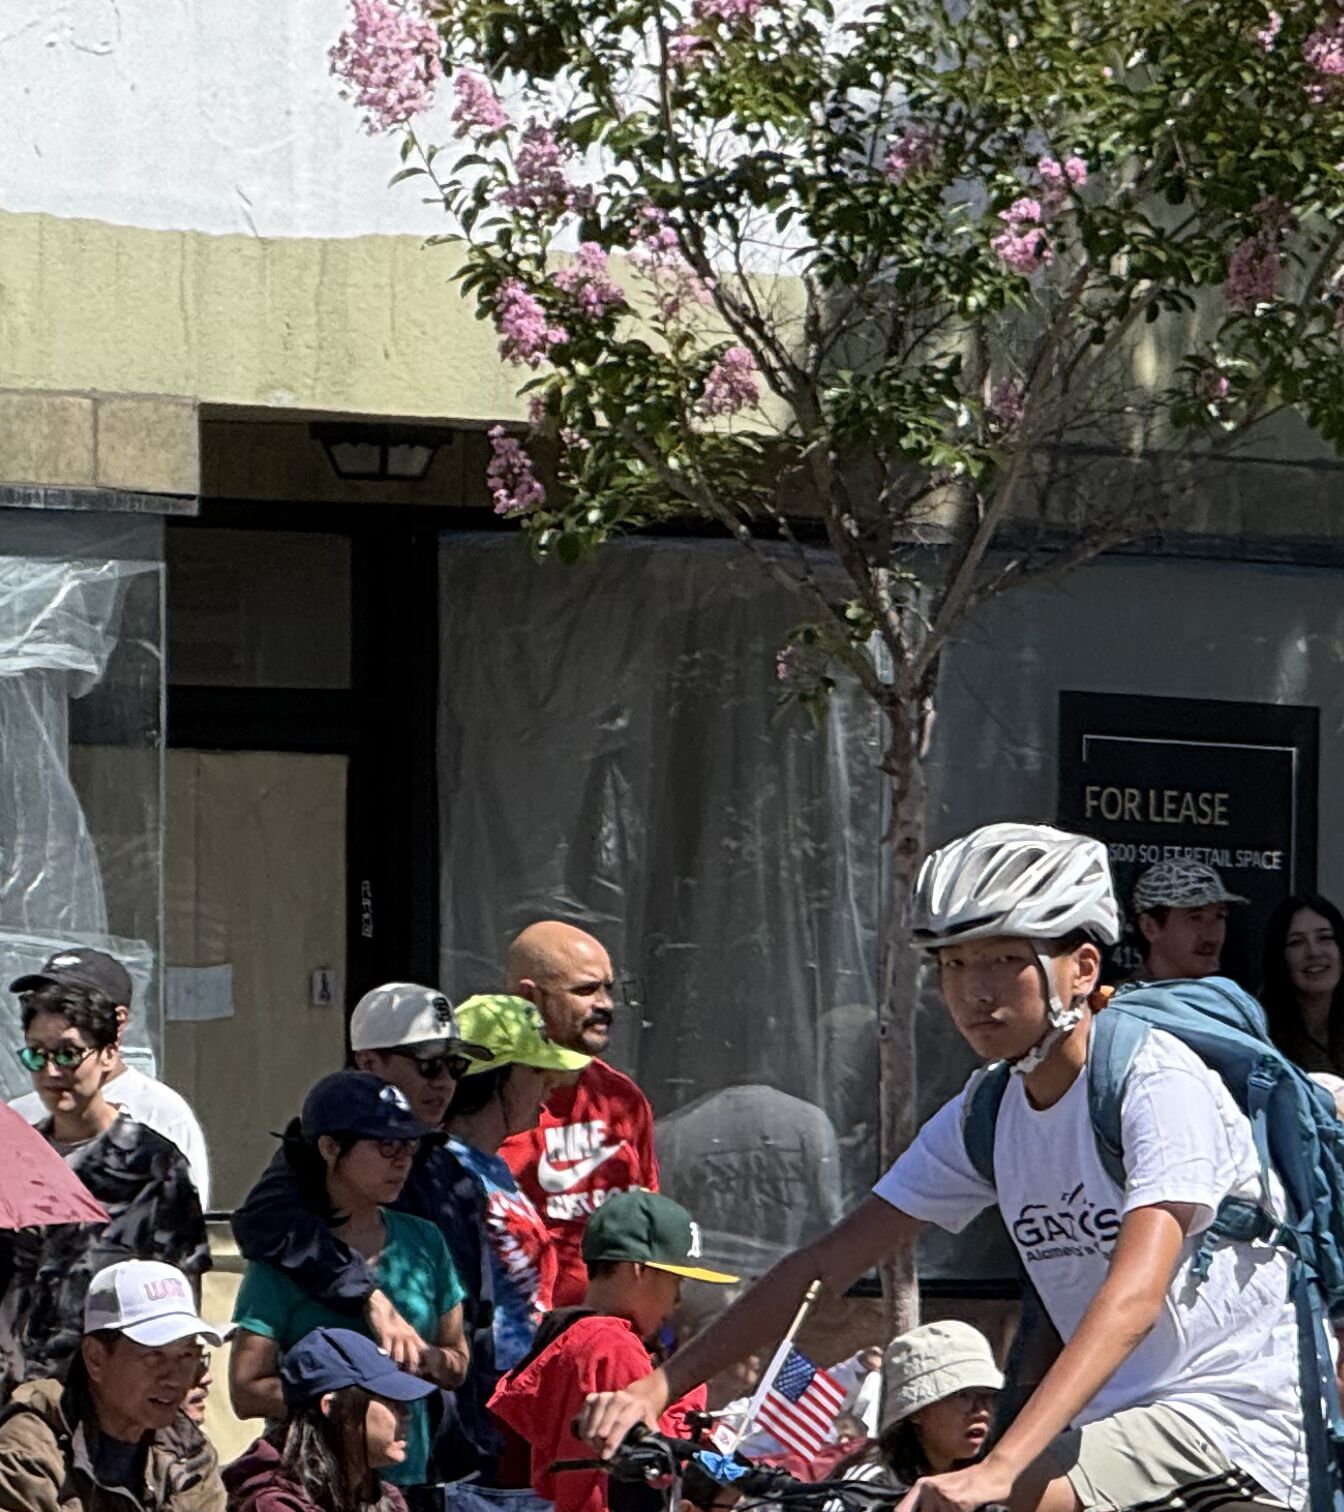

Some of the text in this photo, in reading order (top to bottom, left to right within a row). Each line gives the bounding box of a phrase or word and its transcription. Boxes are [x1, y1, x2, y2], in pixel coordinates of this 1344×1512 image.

[1084, 785, 1230, 826] FOR LEASE
[1184, 847, 1234, 868] RETAIL
[1235, 850, 1283, 871] SPACE
[545, 1119, 609, 1163] NIKE
